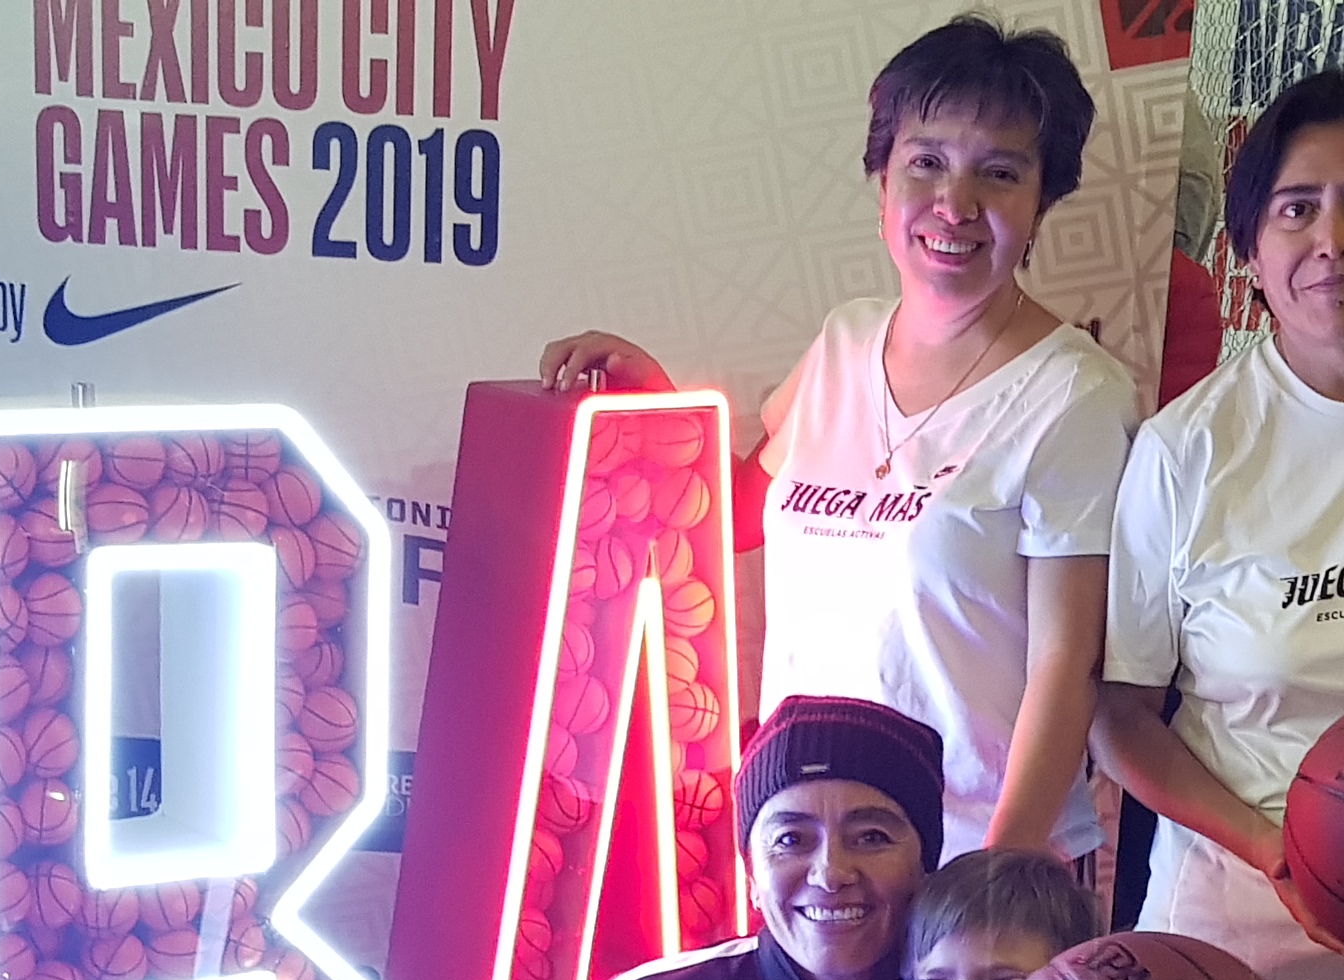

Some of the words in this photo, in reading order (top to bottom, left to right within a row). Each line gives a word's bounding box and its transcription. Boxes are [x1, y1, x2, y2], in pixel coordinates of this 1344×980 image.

[33, 0, 318, 111] MEXICO
[341, 0, 515, 120] CITY
[35, 104, 289, 255] GAMES
[311, 120, 501, 267] 2019
[781, 480, 868, 520] JUEGA
